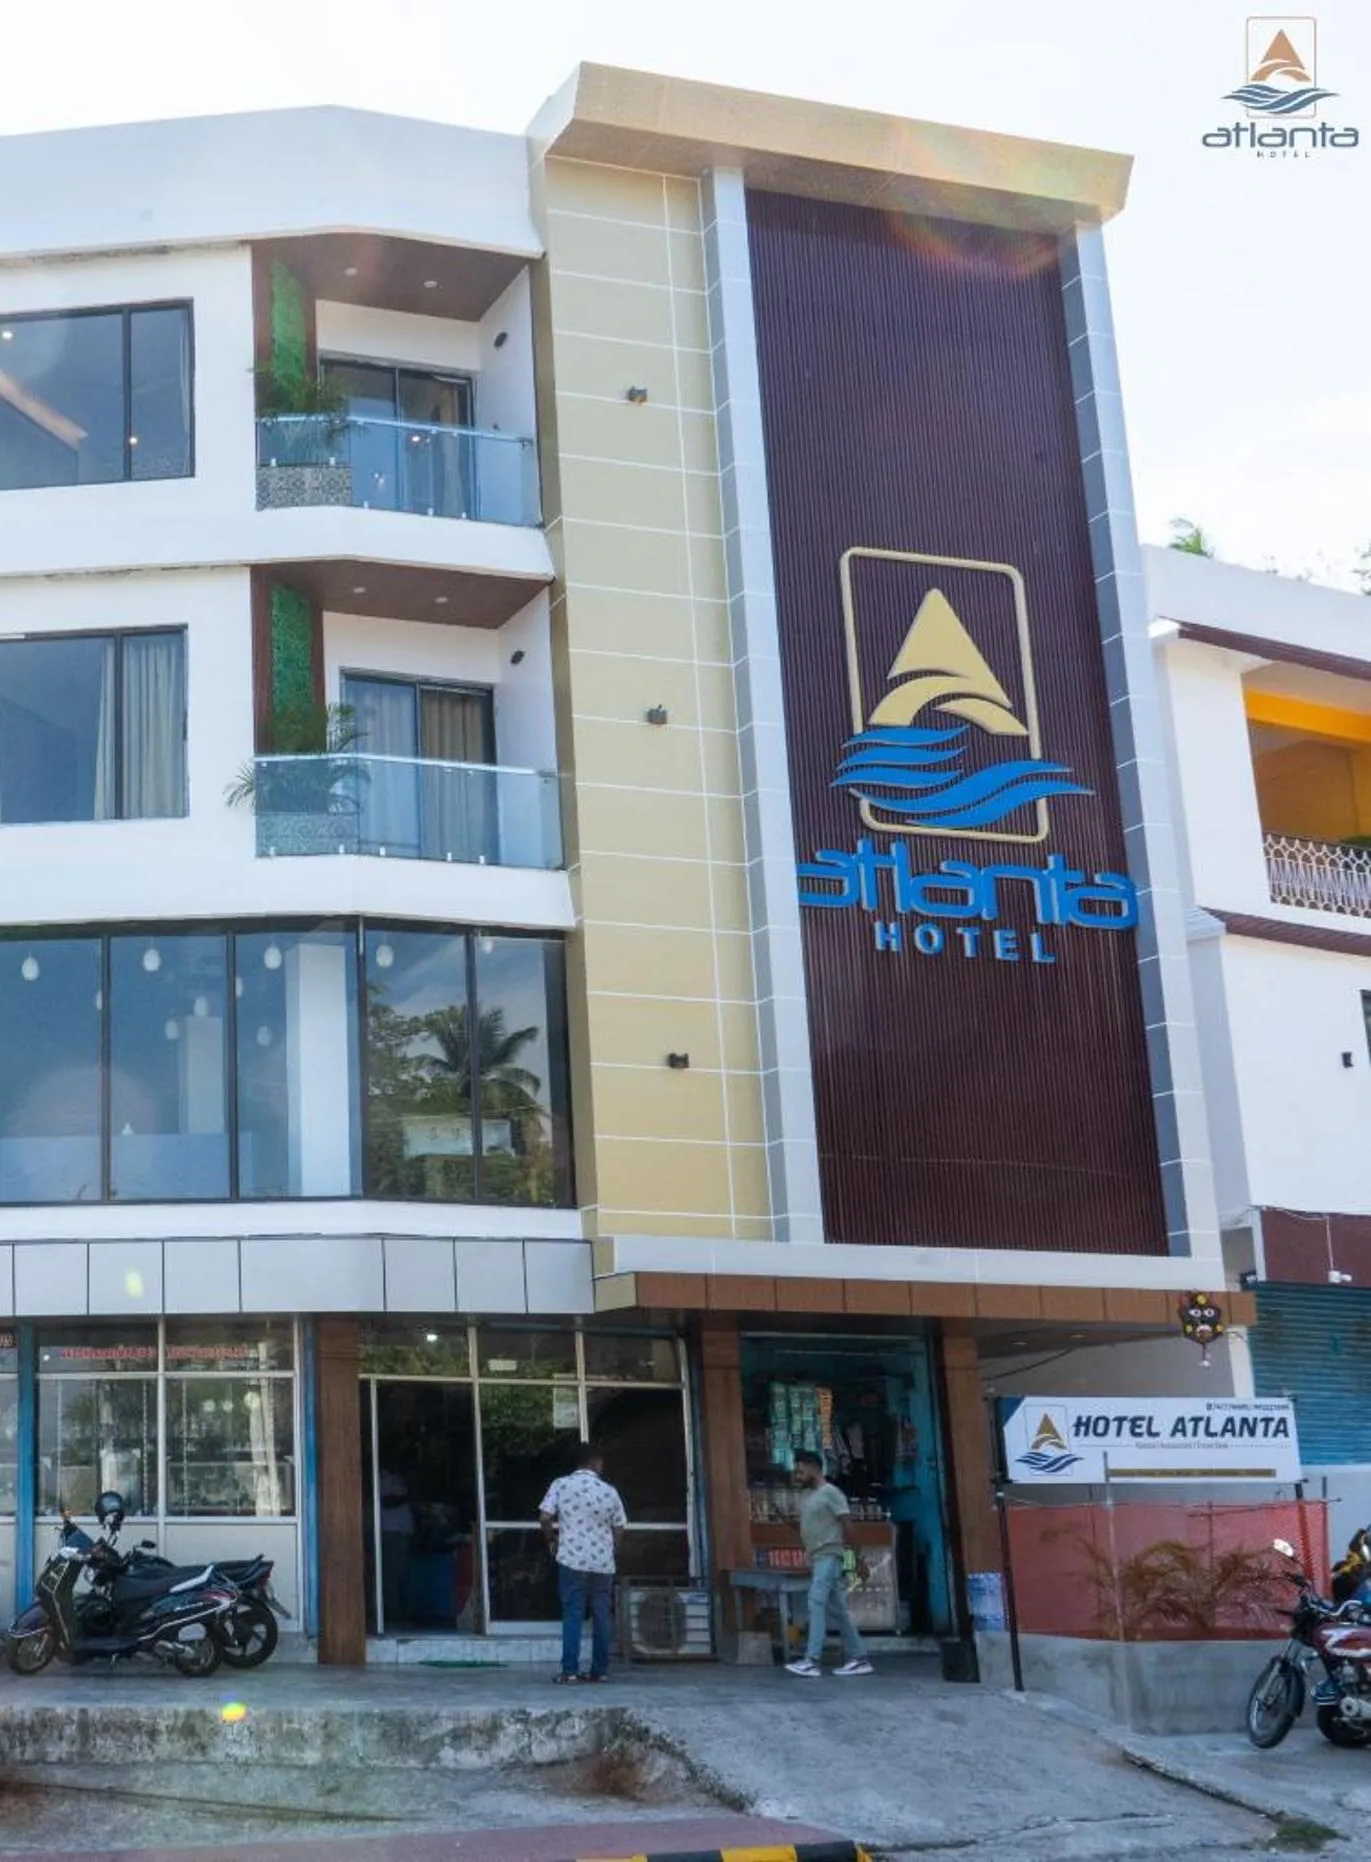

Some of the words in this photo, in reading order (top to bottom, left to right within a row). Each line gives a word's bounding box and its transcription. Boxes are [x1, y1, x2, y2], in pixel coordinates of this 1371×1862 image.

[796, 836, 1139, 930] atlanta
[874, 920, 1057, 964] HOTEL
[1073, 1415, 1161, 1438] HOTEL
[1170, 1416, 1290, 1438] ATLANTA
